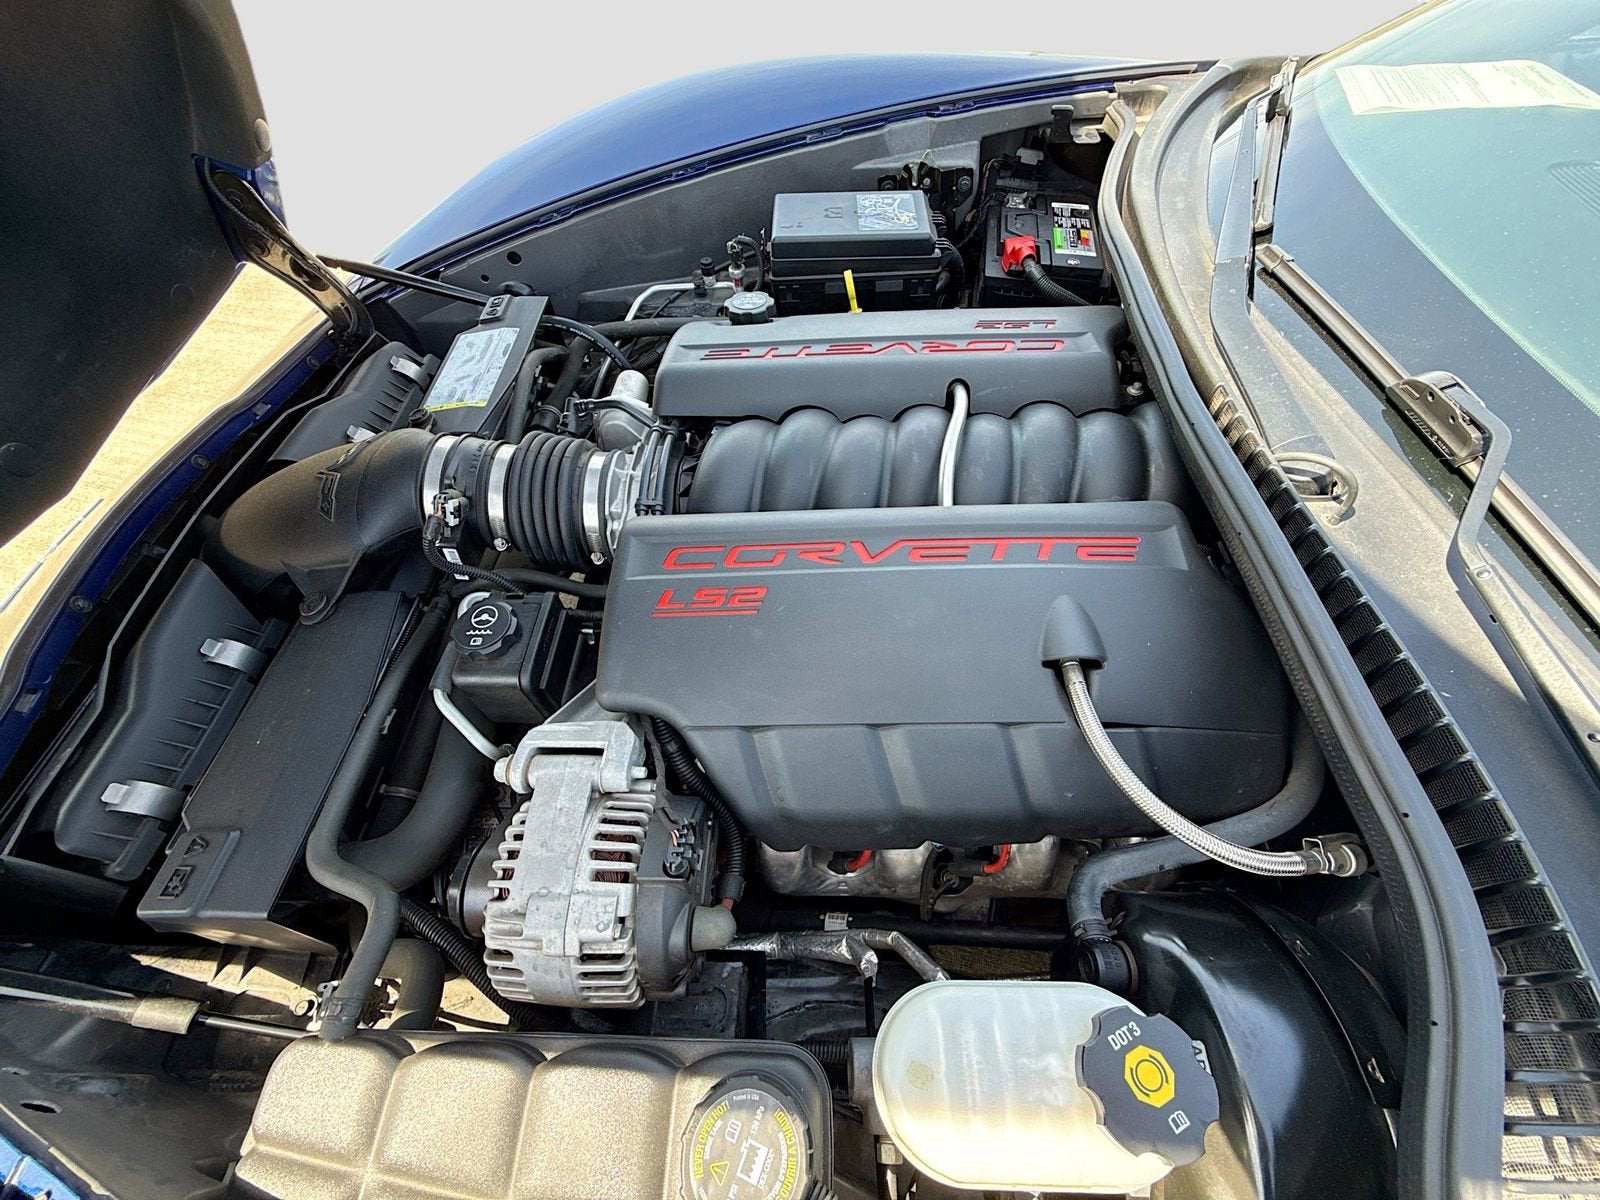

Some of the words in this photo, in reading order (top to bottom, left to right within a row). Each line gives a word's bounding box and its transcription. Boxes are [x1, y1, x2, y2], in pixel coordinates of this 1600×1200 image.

[699, 338, 1065, 361] CORVETTE
[663, 536, 1142, 570] CORVETTE
[654, 586, 768, 612] LS2
[1107, 1025, 1133, 1051] DOT
[1129, 1021, 1141, 1037] 3
[713, 1100, 730, 1121] HOT!
[698, 1118, 714, 1143] OPEN
[774, 1108, 796, 1145] CHAUD!
[693, 1145, 705, 1180] NEVER
[780, 1157, 797, 1197] OUVRIR
